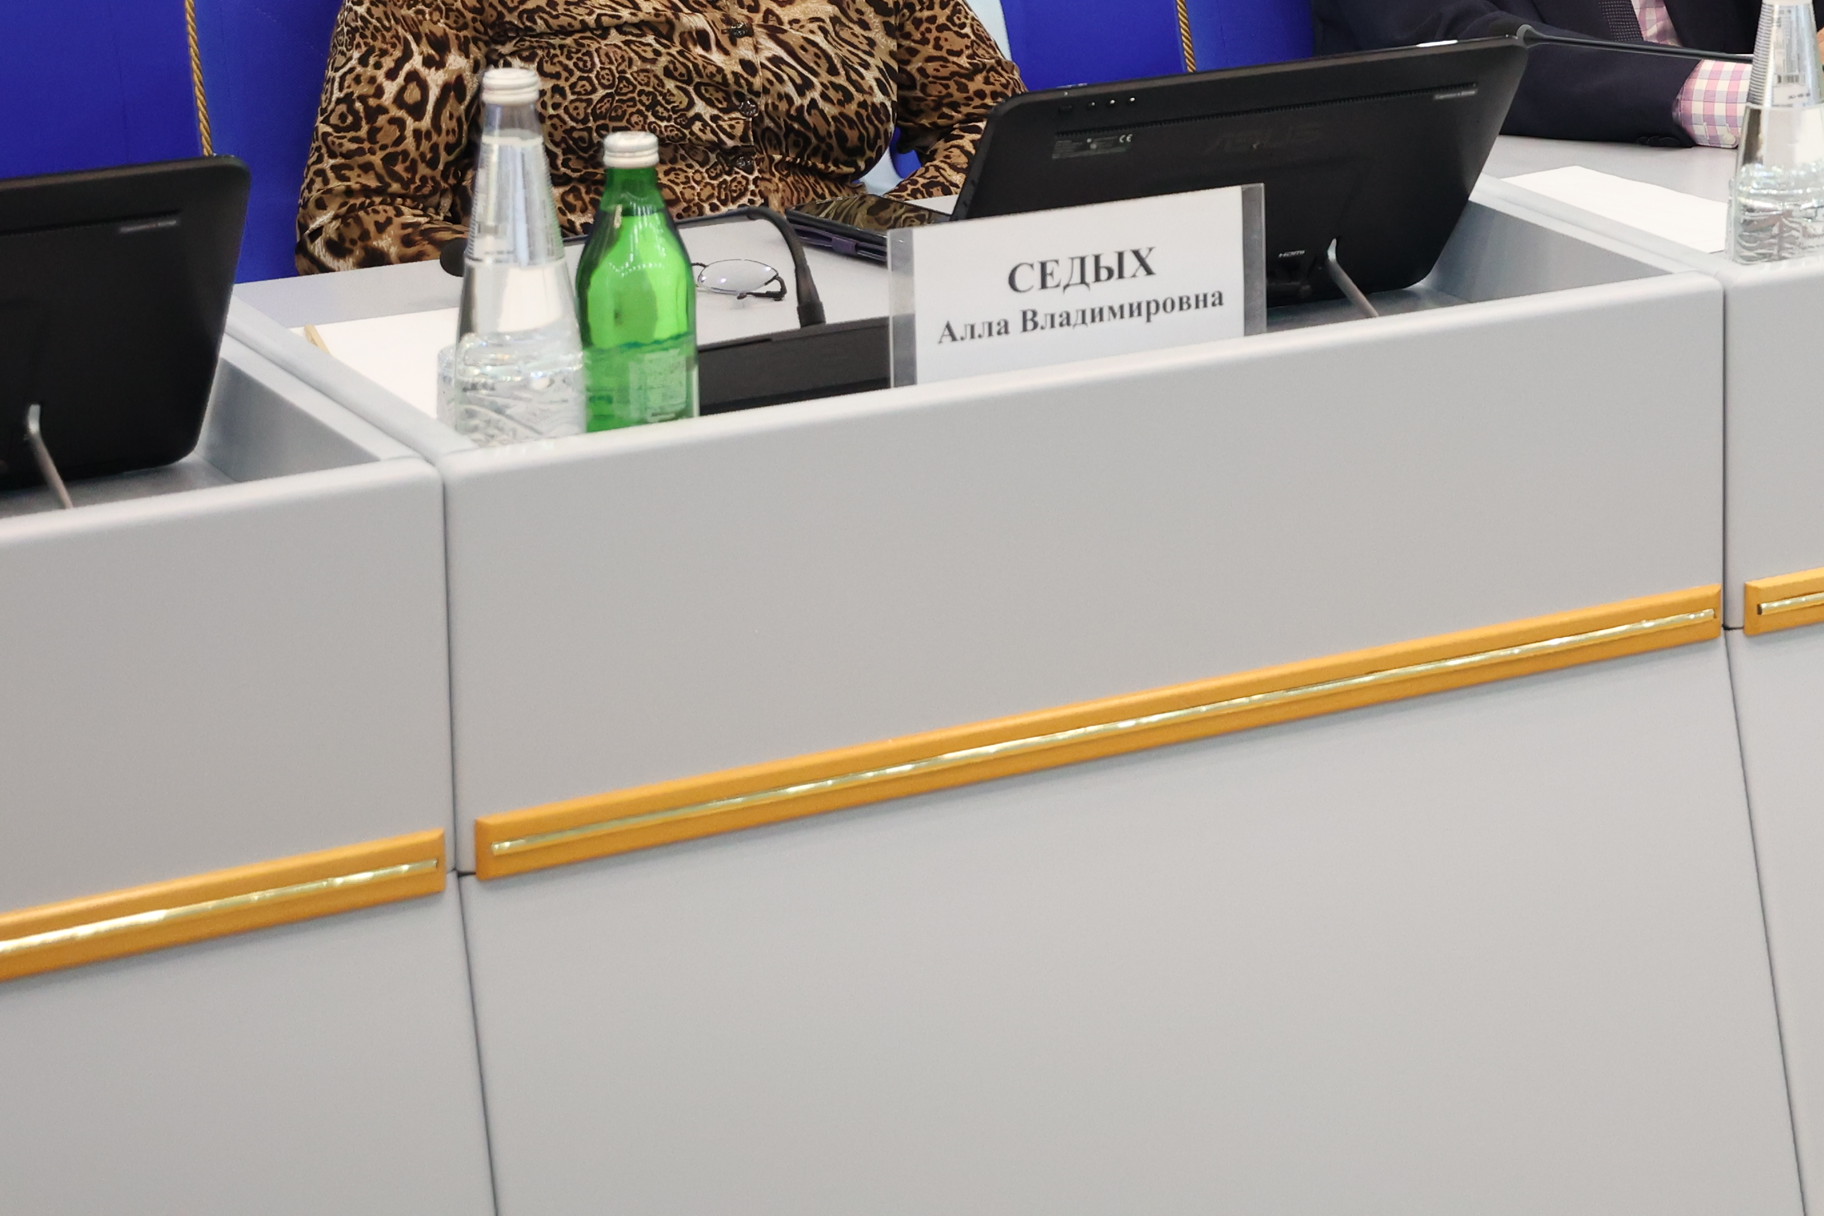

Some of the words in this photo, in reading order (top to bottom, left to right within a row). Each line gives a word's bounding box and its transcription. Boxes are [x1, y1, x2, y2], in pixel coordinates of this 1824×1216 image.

[1007, 246, 1157, 295] СЕДЫХ
[937, 315, 1011, 345] Алла
[1019, 290, 1225, 334] Владимировна
